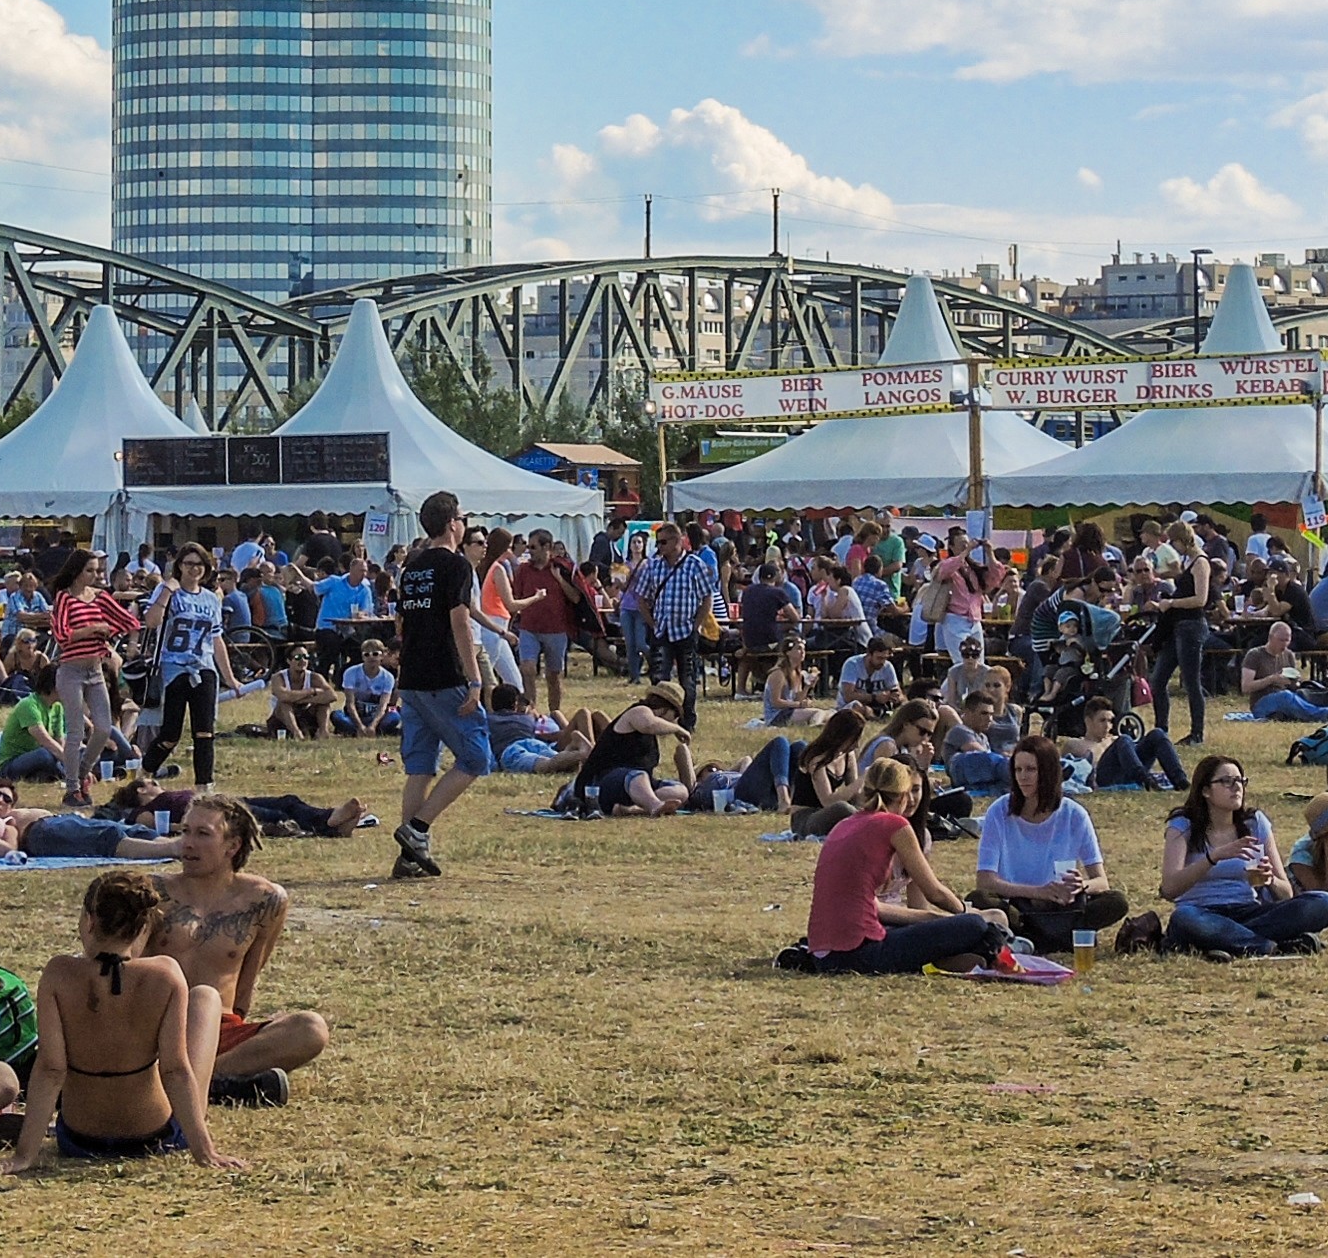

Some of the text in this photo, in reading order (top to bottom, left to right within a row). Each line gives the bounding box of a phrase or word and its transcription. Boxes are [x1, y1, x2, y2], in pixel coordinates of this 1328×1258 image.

[662, 370, 943, 400] G.MÄUSE BIER POMMES
[996, 356, 1319, 387] CURRY WURST BIER WÜRSTEL
[662, 388, 942, 418] HOT-DOG WEIN LANGOS
[1006, 379, 1302, 404] W. BURGER DRINKS KEBAB
[368, 524, 386, 532] 120
[1307, 514, 1326, 526] 119
[168, 618, 212, 656] 67
